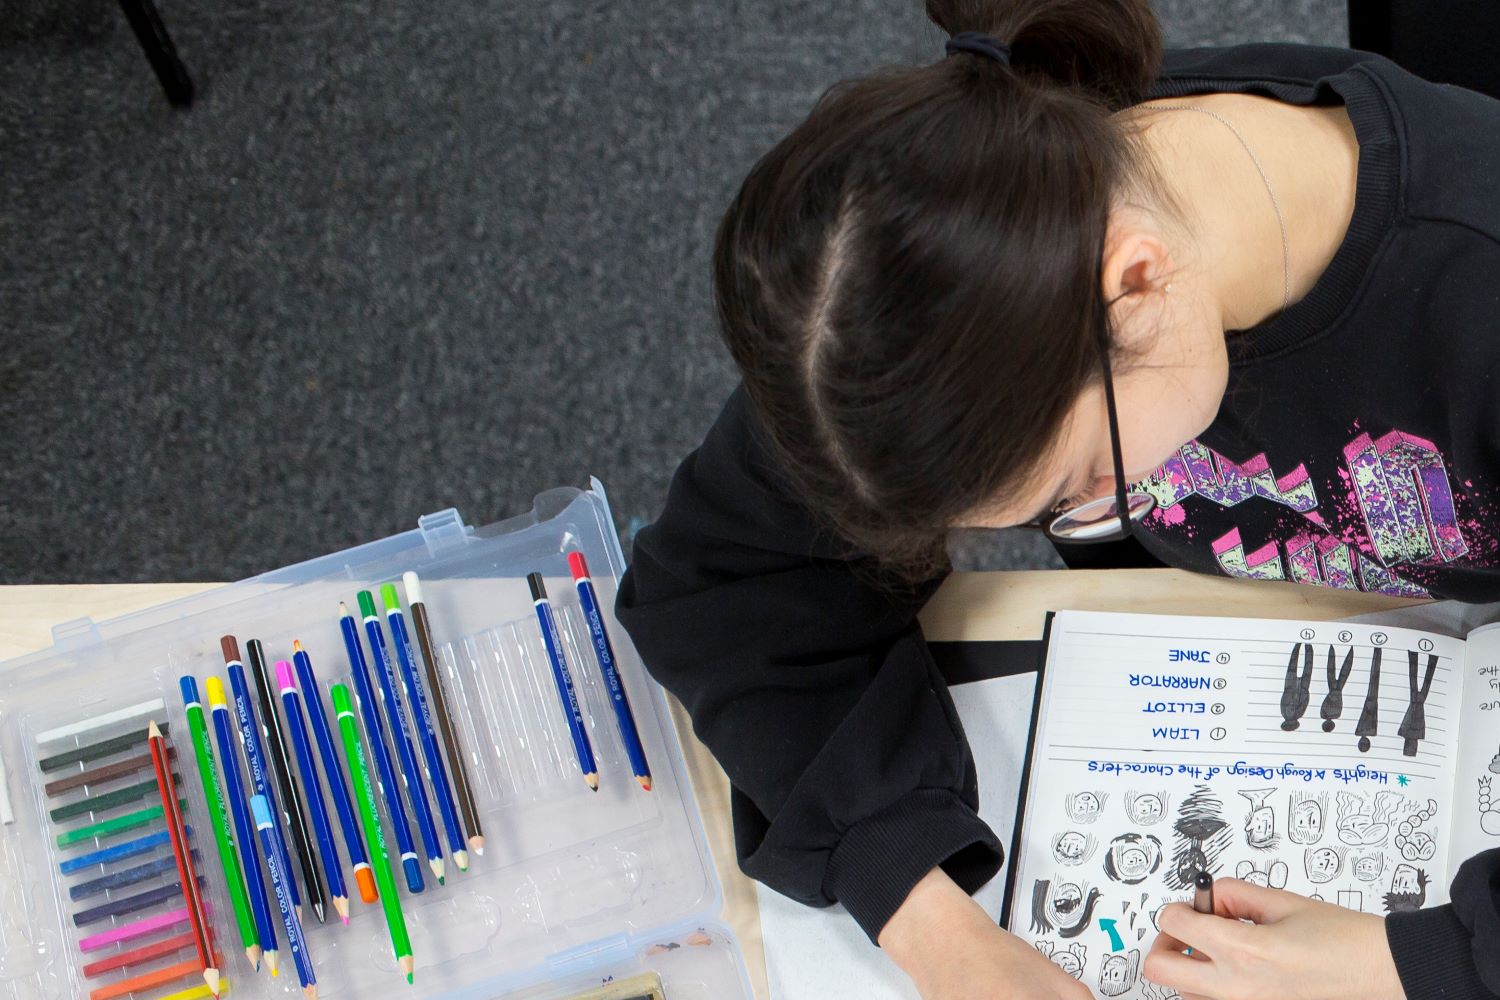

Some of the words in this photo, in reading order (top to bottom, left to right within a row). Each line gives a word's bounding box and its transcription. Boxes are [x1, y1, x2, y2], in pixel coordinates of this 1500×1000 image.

[588, 607, 601, 635] PENCIL
[598, 637, 610, 663] COLOR
[1168, 649, 1210, 662] JANE
[606, 665, 618, 690] ROYAL
[1478, 665, 1498, 676] the
[1129, 673, 1210, 688] NARRATOR
[235, 696, 248, 723] PENCIL
[1142, 702, 1205, 713] ELLIOT
[242, 725, 256, 753] COLOR
[1152, 727, 1199, 739] LIAM
[249, 755, 262, 781] ROYAL
[1087, 761, 1172, 776] Characters
[1177, 764, 1199, 778] the
[1203, 767, 1219, 779] of
[1226, 762, 1273, 779] Design
[1275, 766, 1312, 781] Rough
[1333, 765, 1387, 784] Heights
[266, 853, 280, 883] PENCIL
[274, 885, 288, 913] COLOR
[282, 915, 297, 942] ROYAL
